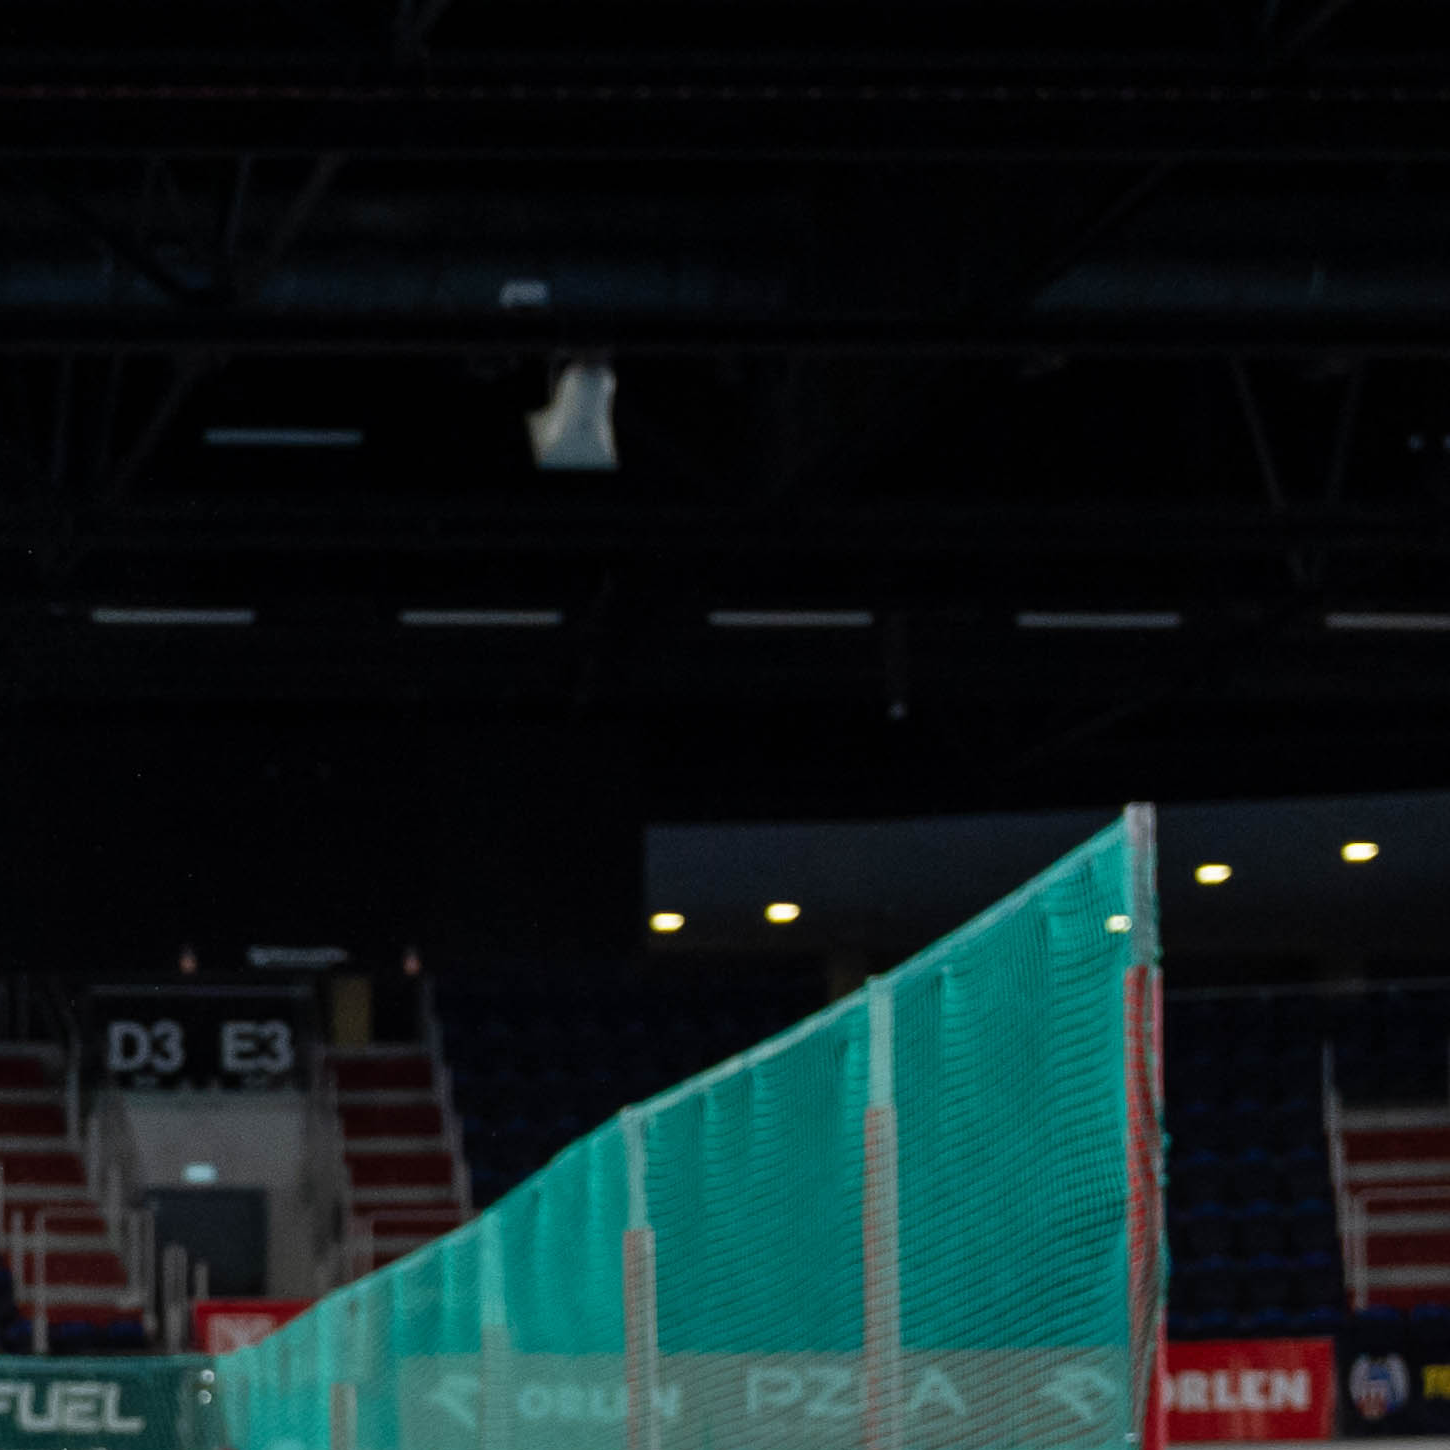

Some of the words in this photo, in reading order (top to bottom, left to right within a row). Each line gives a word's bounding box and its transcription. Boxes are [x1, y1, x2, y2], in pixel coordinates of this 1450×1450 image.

[108, 1019, 184, 1073] D3
[221, 1020, 294, 1073] E3
[744, 1366, 967, 1418] PZA
